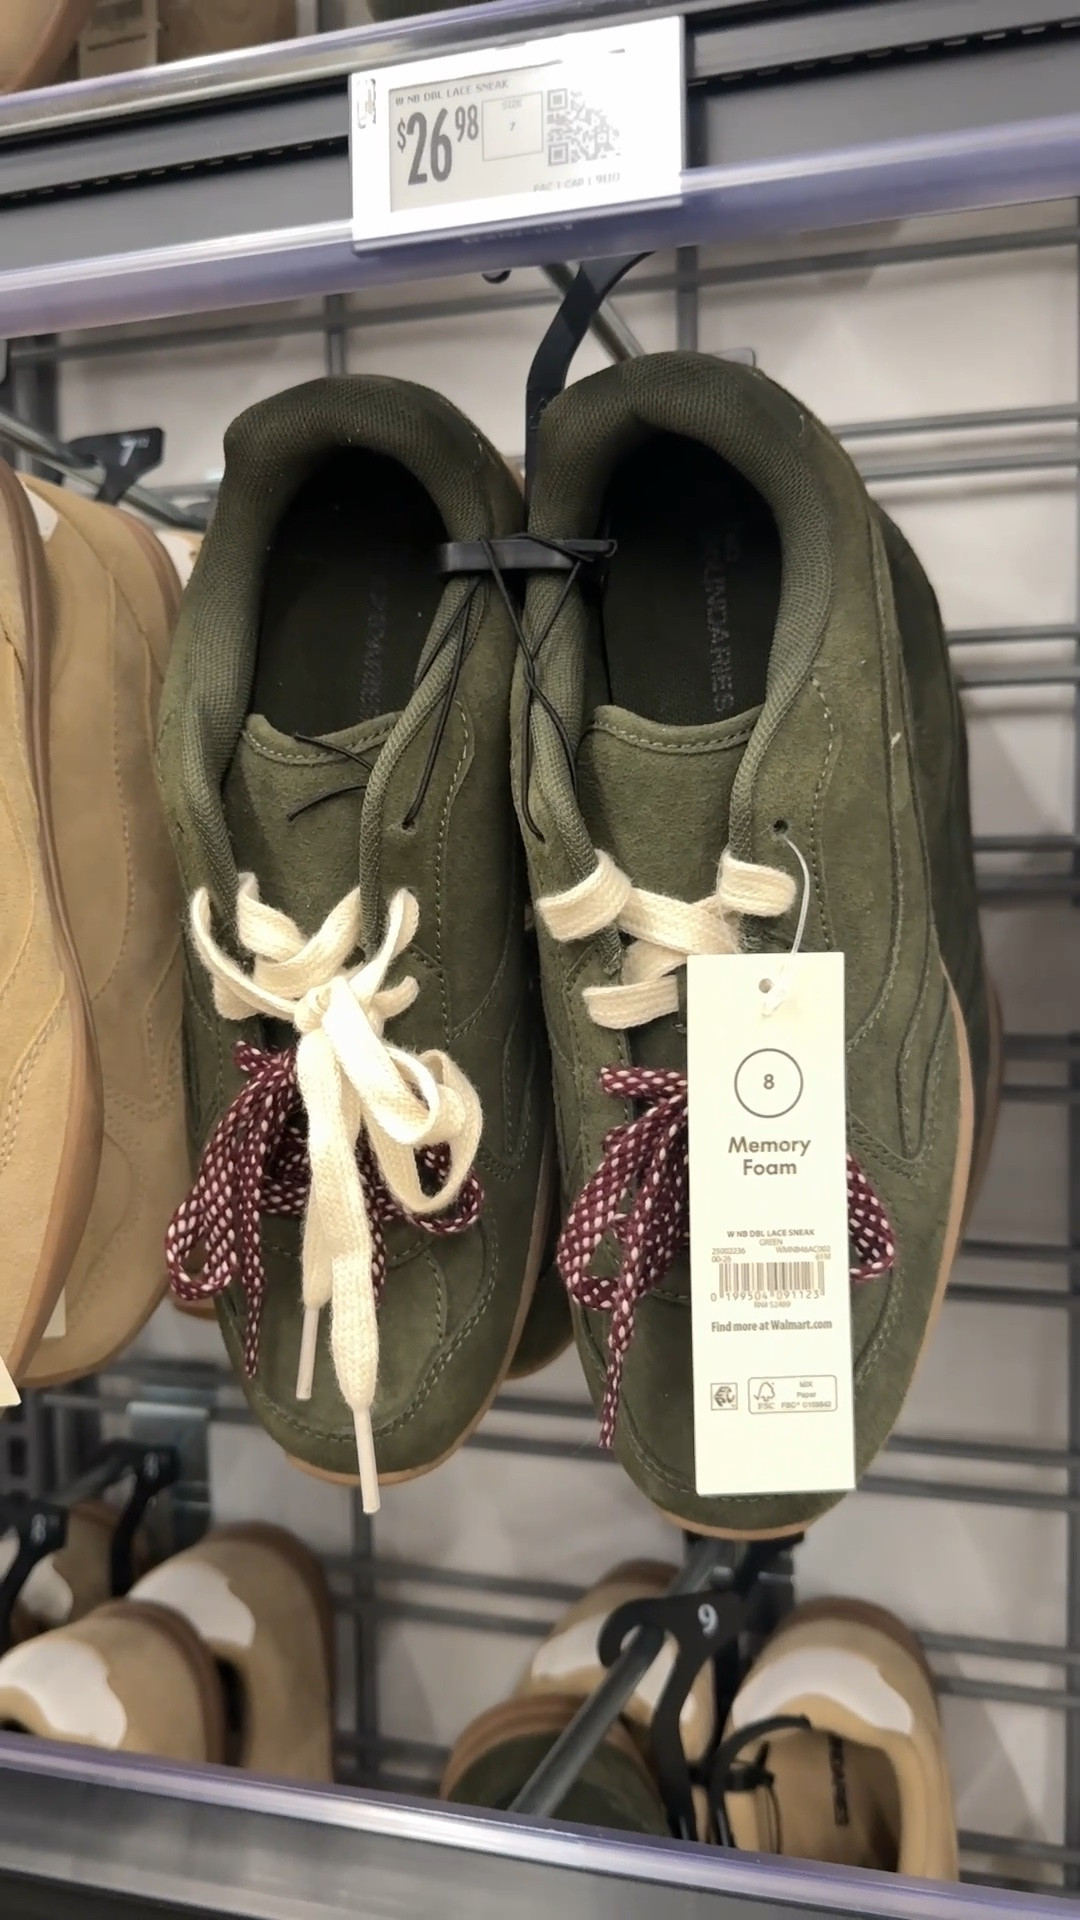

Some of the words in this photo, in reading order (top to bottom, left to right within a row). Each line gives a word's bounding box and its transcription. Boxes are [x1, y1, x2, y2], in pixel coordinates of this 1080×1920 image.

[396, 96, 404, 106] W
[408, 94, 420, 104] NB
[424, 91, 442, 101] DBL
[446, 85, 472, 98] LACE
[476, 79, 509, 93] SNEAK
[509, 120, 516, 132] 7
[763, 1074, 775, 1090] 8
[728, 1136, 811, 1156] Memory
[742, 1158, 797, 1176] Foam
[767, 1229, 786, 1237] LACE
[758, 1238, 783, 1246] GREEN
[710, 1293, 717, 1302] 0
[711, 1321, 731, 1332] Find
[733, 1323, 756, 1331] more
[759, 1321, 769, 1331] at
[770, 1319, 832, 1330] Walmart.com
[697, 1604, 718, 1636] 9
